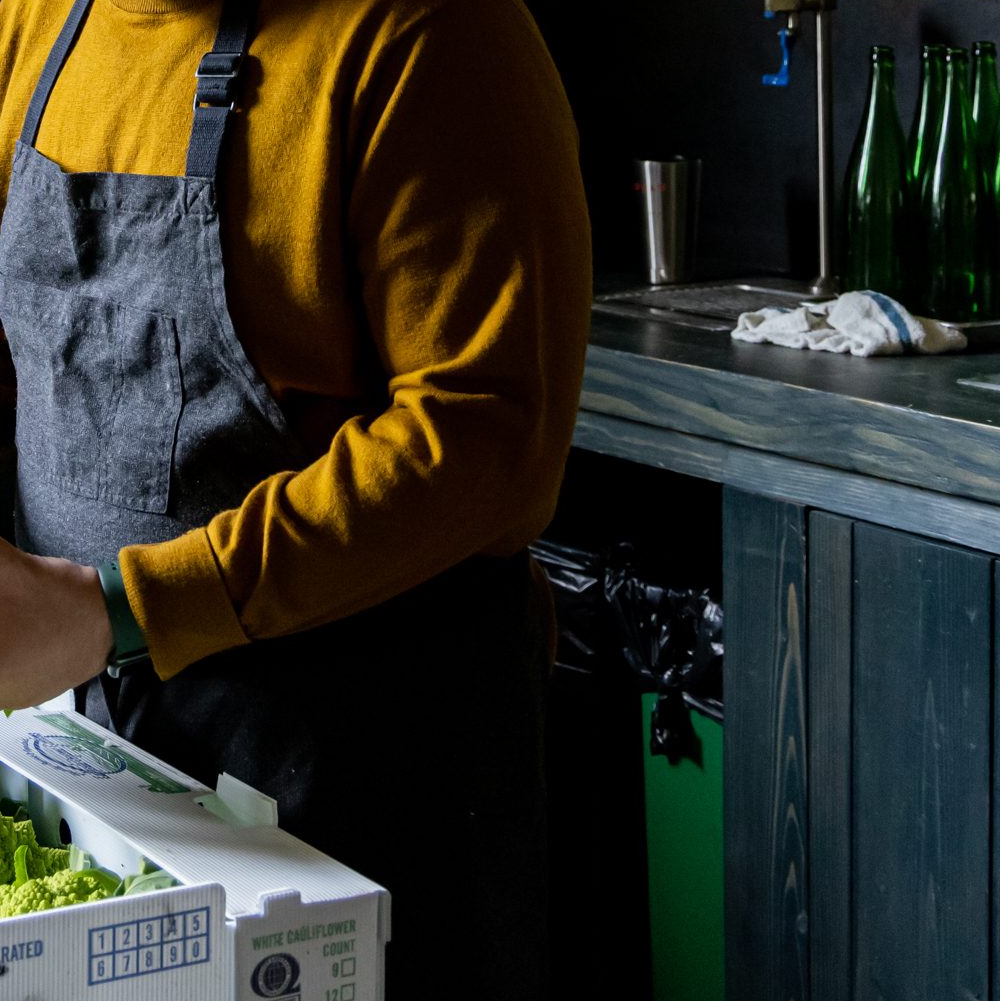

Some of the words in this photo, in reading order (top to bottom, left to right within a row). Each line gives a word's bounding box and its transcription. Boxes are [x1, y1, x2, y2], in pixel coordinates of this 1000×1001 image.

[98, 933, 105, 950] 1
[123, 928, 131, 945] 2
[146, 924, 153, 941] 3
[193, 915, 200, 931] 5
[252, 932, 284, 951] WHITE
[287, 920, 356, 945] CAULIFLOWER
[98, 961, 105, 977] 6
[123, 955, 130, 972] 7
[146, 951, 153, 967] 8
[170, 946, 177, 962] 9
[193, 941, 200, 958] 0
[323, 939, 356, 957] COUNT
[332, 962, 339, 978] 9
[326, 988, 339, 1001] 12
